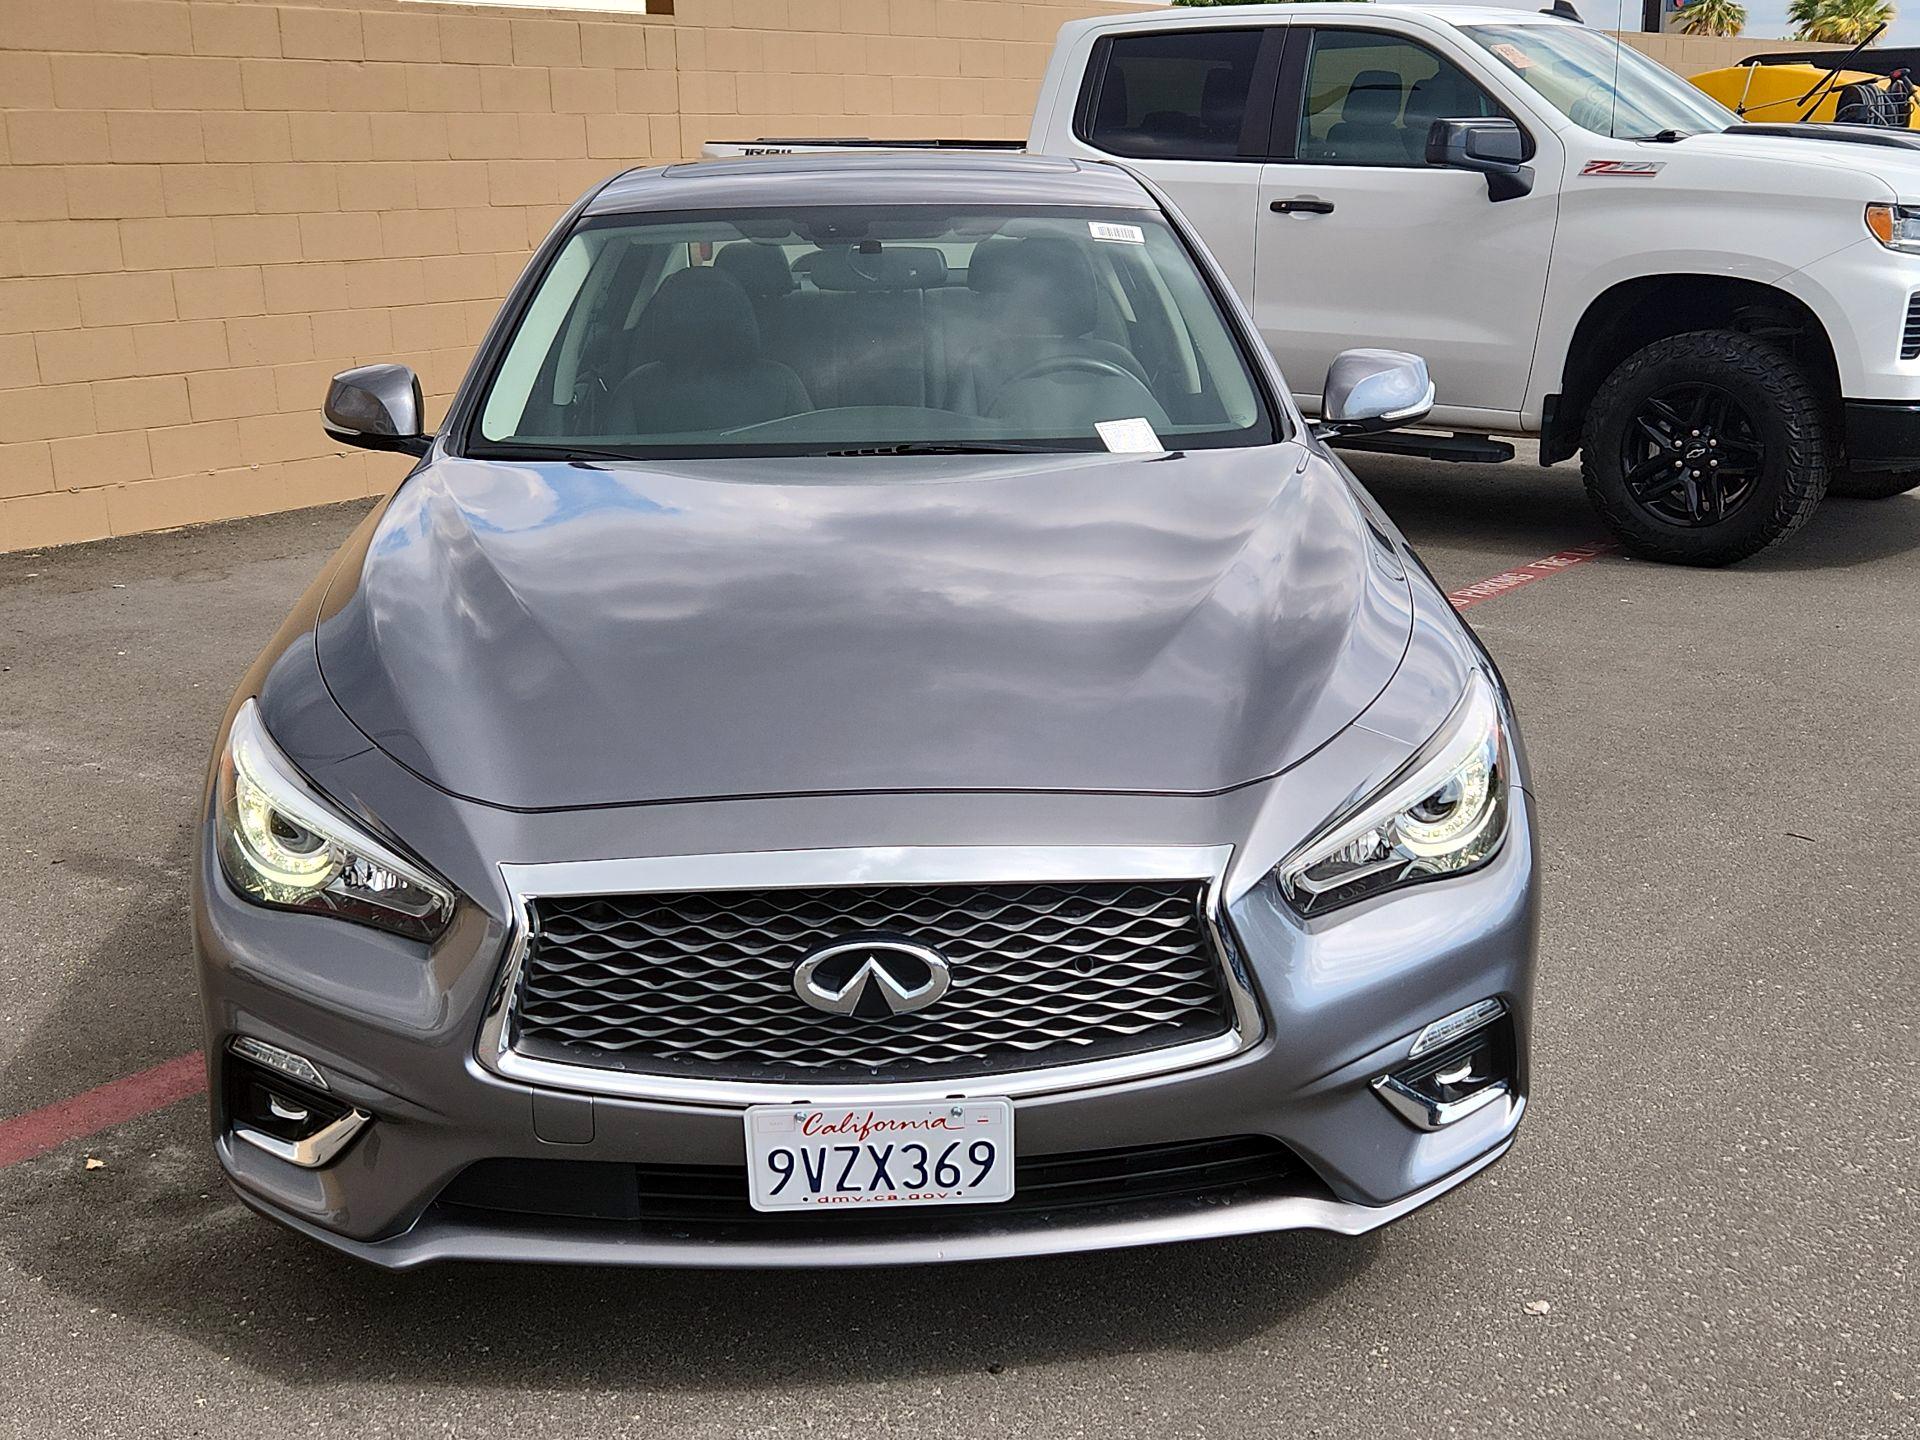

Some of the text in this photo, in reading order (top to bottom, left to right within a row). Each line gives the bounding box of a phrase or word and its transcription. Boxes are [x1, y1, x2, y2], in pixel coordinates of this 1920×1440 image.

[1583, 160, 1657, 177] Z71
[803, 1111, 965, 1141] California
[767, 1140, 996, 1196] 9VZX369
[817, 1191, 949, 1204] dmv.ca.gov
